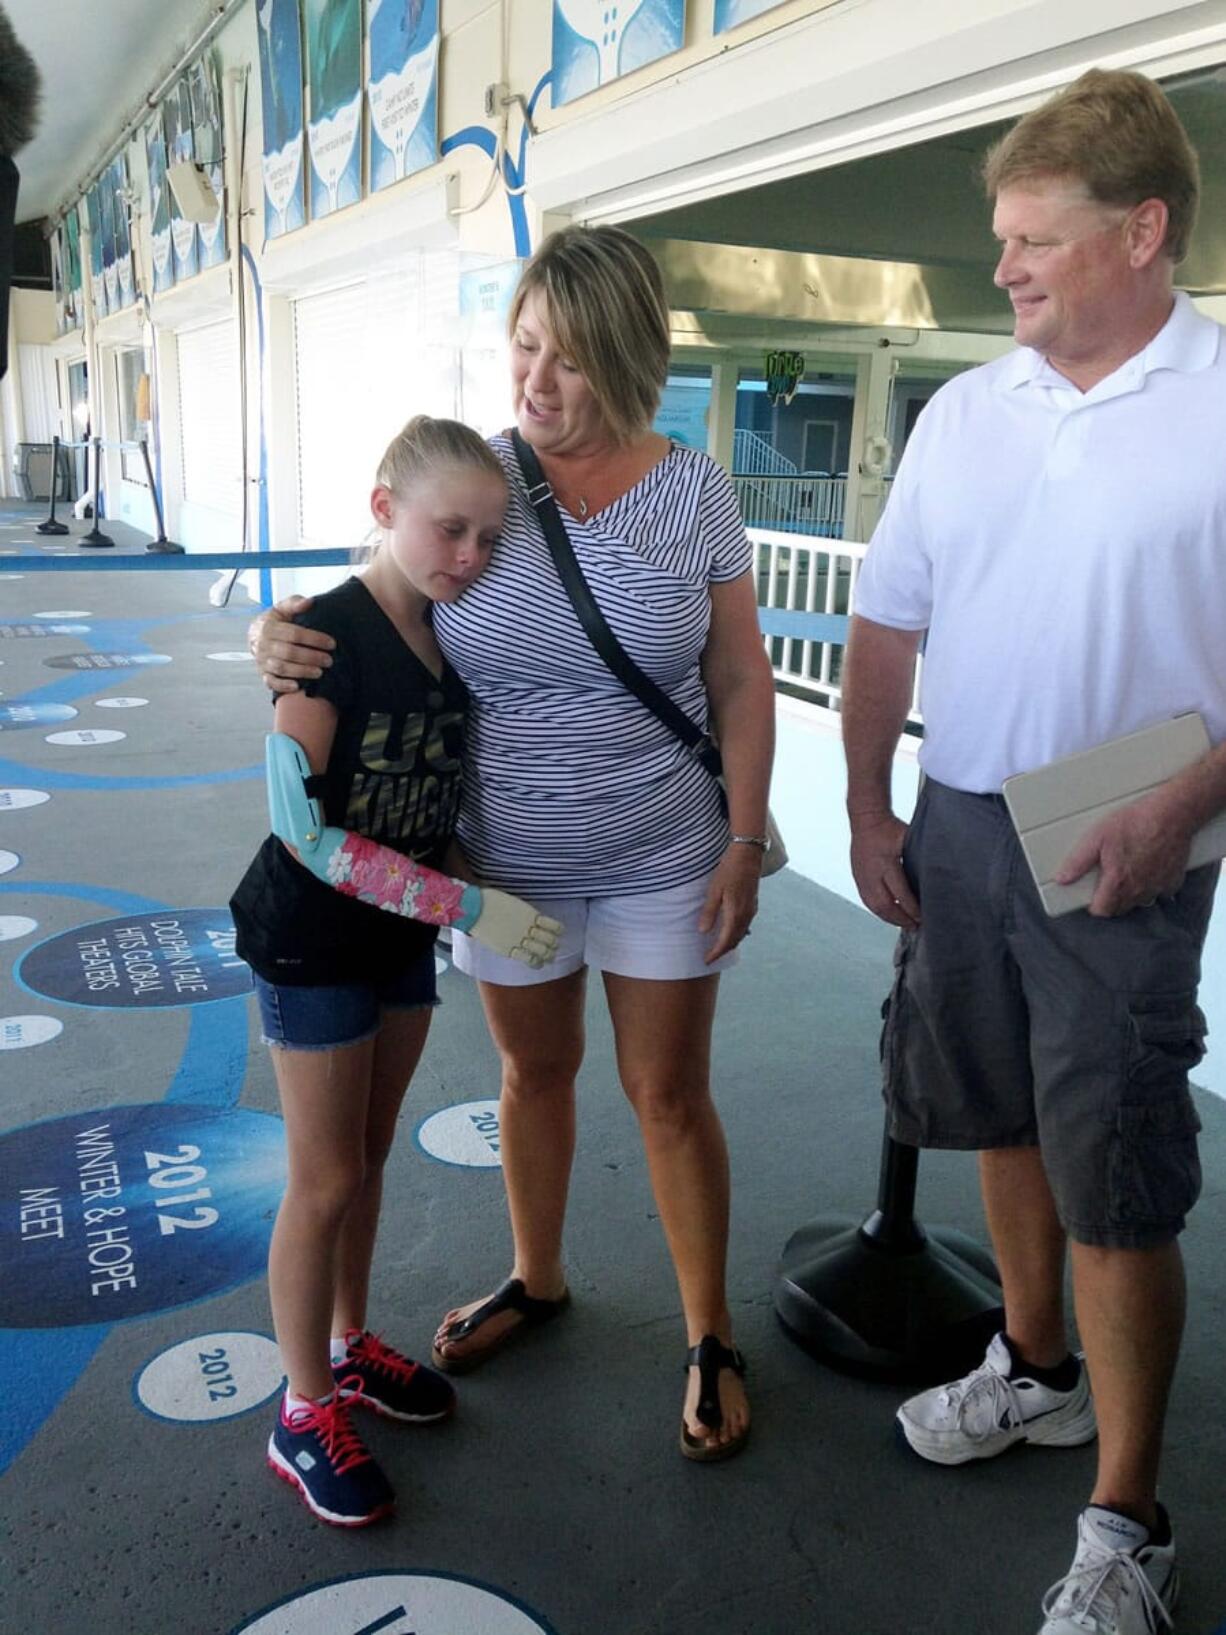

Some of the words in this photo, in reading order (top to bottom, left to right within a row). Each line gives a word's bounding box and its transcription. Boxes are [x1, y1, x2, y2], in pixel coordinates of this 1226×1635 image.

[360, 711, 464, 774] UC
[345, 773, 461, 838] KNIGH
[77, 938, 120, 991] THEATERS
[115, 926, 148, 949] HITS
[150, 920, 196, 967] DOLPHIN
[121, 950, 164, 995] GLOBAL
[170, 966, 208, 992] TALE
[75, 1124, 122, 1204] WINTER
[144, 1145, 220, 1236] 2012
[19, 1186, 65, 1241] MEET
[83, 1206, 126, 1226] &
[86, 1226, 137, 1296] HOPE
[198, 1348, 238, 1402] 2012
